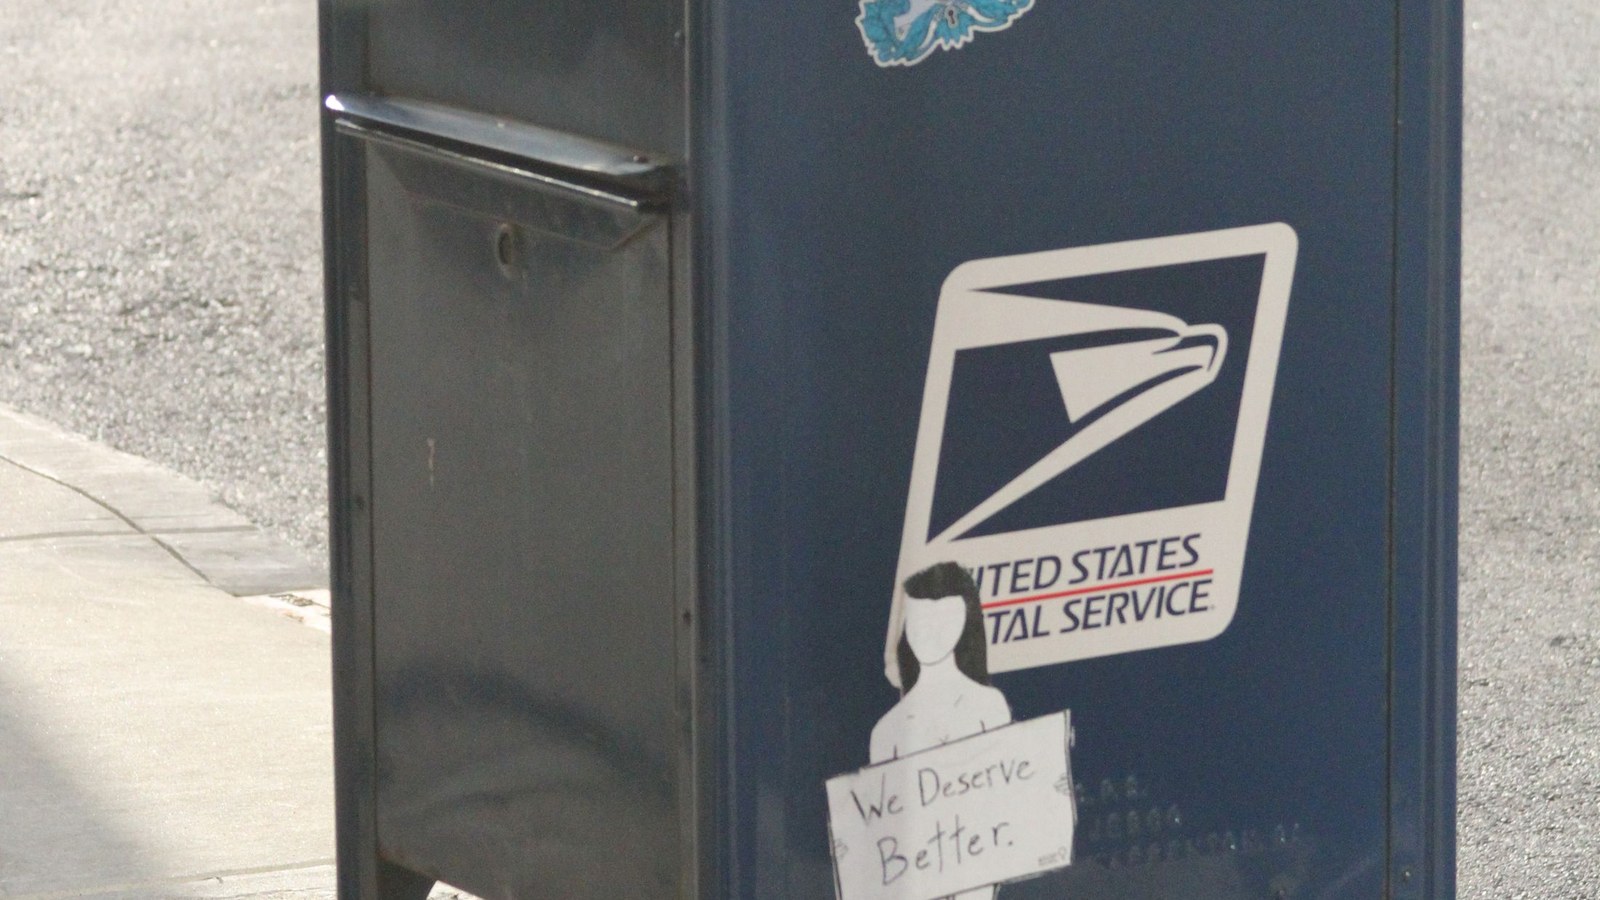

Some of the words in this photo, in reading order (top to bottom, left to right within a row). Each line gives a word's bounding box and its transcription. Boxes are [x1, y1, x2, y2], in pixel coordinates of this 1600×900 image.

[970, 555, 1062, 597] ITED
[1067, 533, 1202, 584] STATES
[987, 605, 1051, 645] TAL
[1060, 579, 1213, 634] SERVICE
[850, 772, 904, 826] We
[918, 758, 1035, 807] Deserve
[876, 815, 1014, 885] Better.
